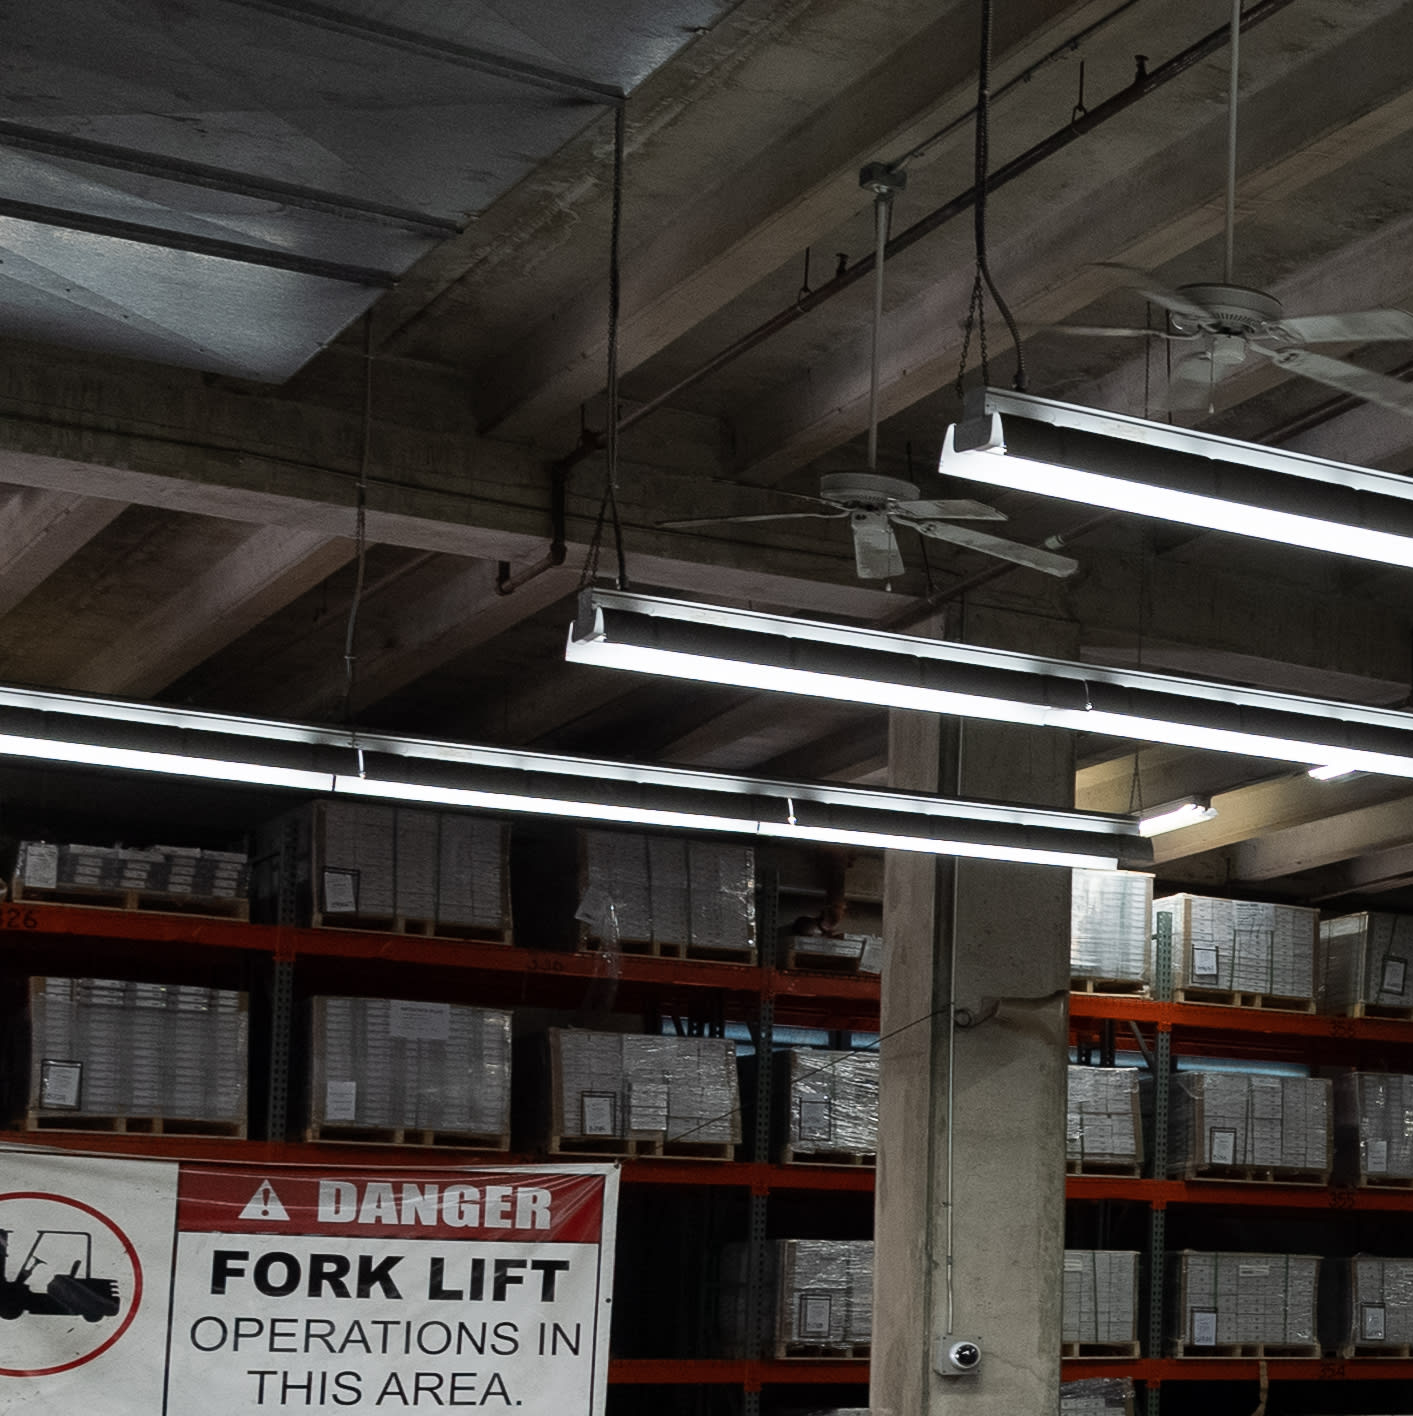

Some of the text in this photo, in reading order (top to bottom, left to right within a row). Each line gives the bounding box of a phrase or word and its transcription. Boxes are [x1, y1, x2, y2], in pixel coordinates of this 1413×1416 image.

[0, 907, 38, 929] 26
[318, 1181, 551, 1230] DANGER
[211, 1250, 570, 1302] FORK LIFT
[190, 1316, 581, 1356] OPERATIONS IN
[247, 1370, 523, 1406] THIS AREA.
